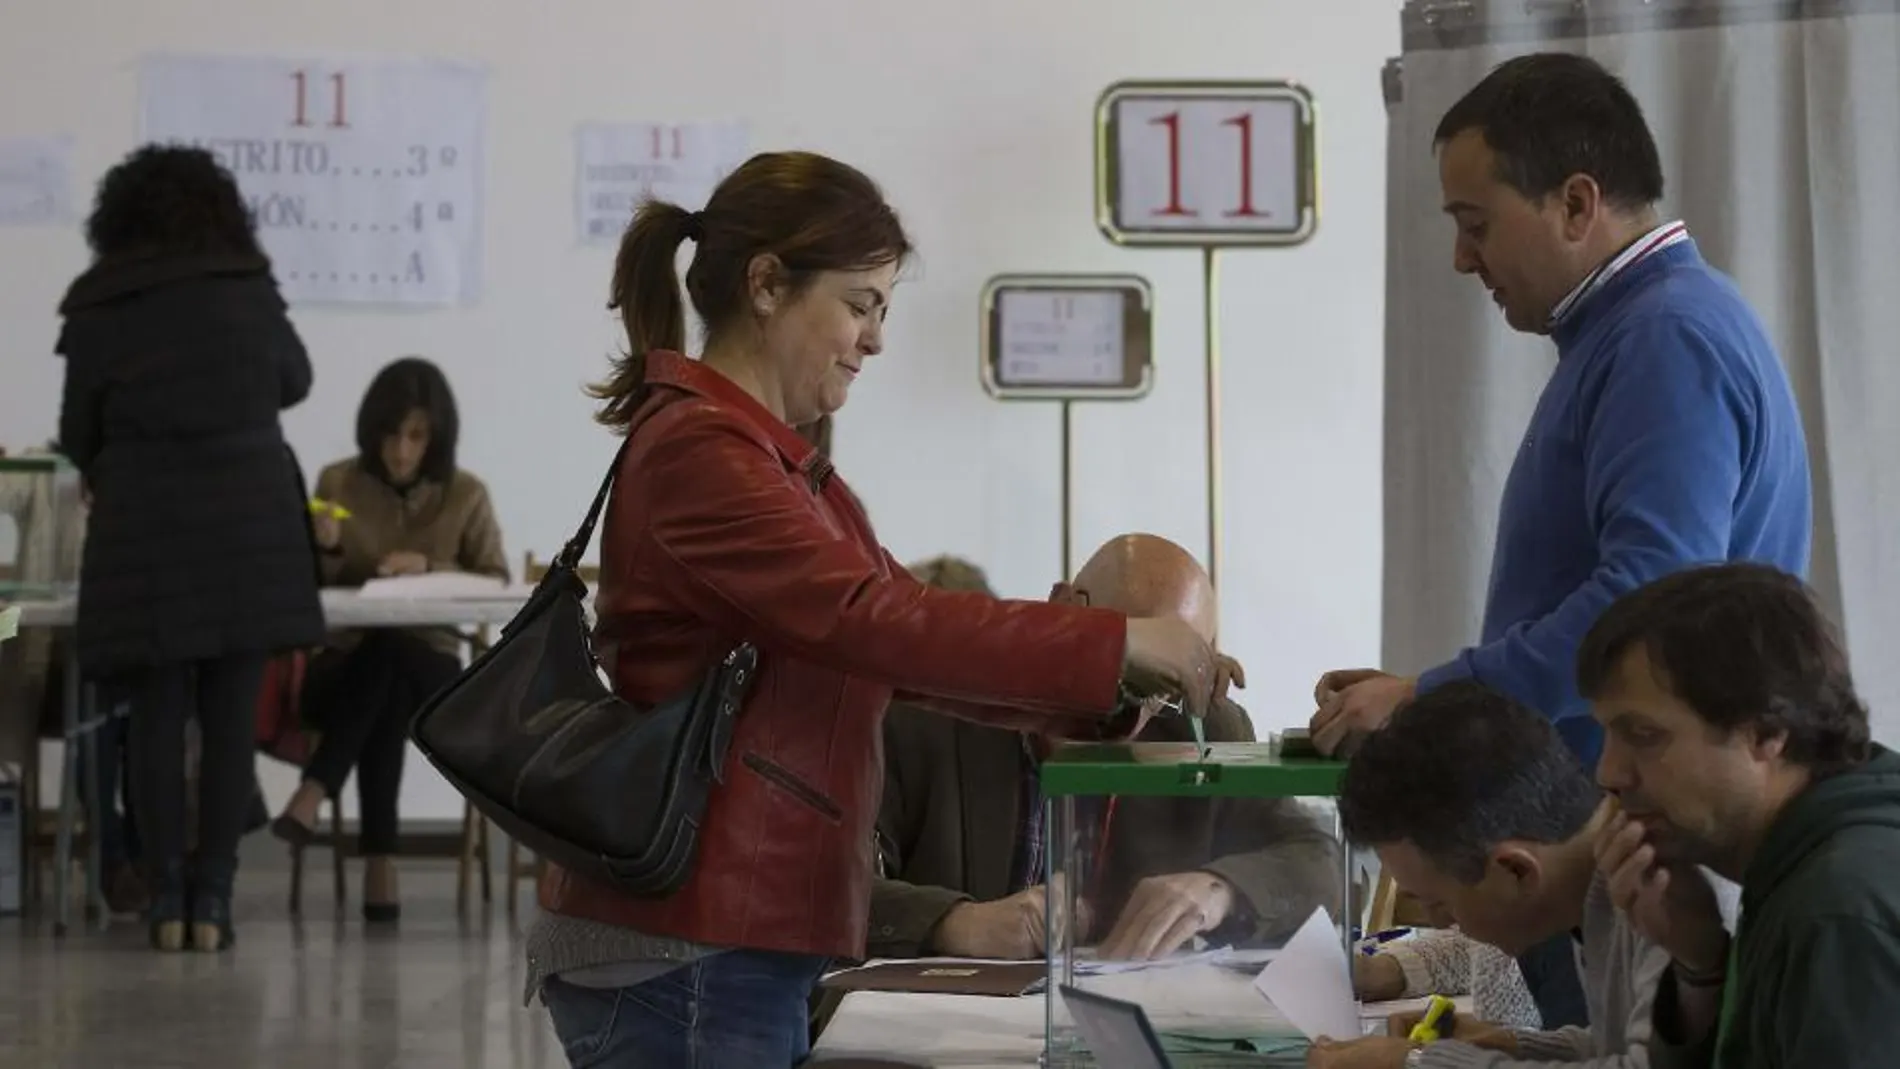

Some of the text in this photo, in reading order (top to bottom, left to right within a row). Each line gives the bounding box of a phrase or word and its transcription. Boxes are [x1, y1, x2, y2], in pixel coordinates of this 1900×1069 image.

[288, 70, 350, 128] 11
[652, 126, 683, 160] 11
[1148, 110, 1272, 217] 11
